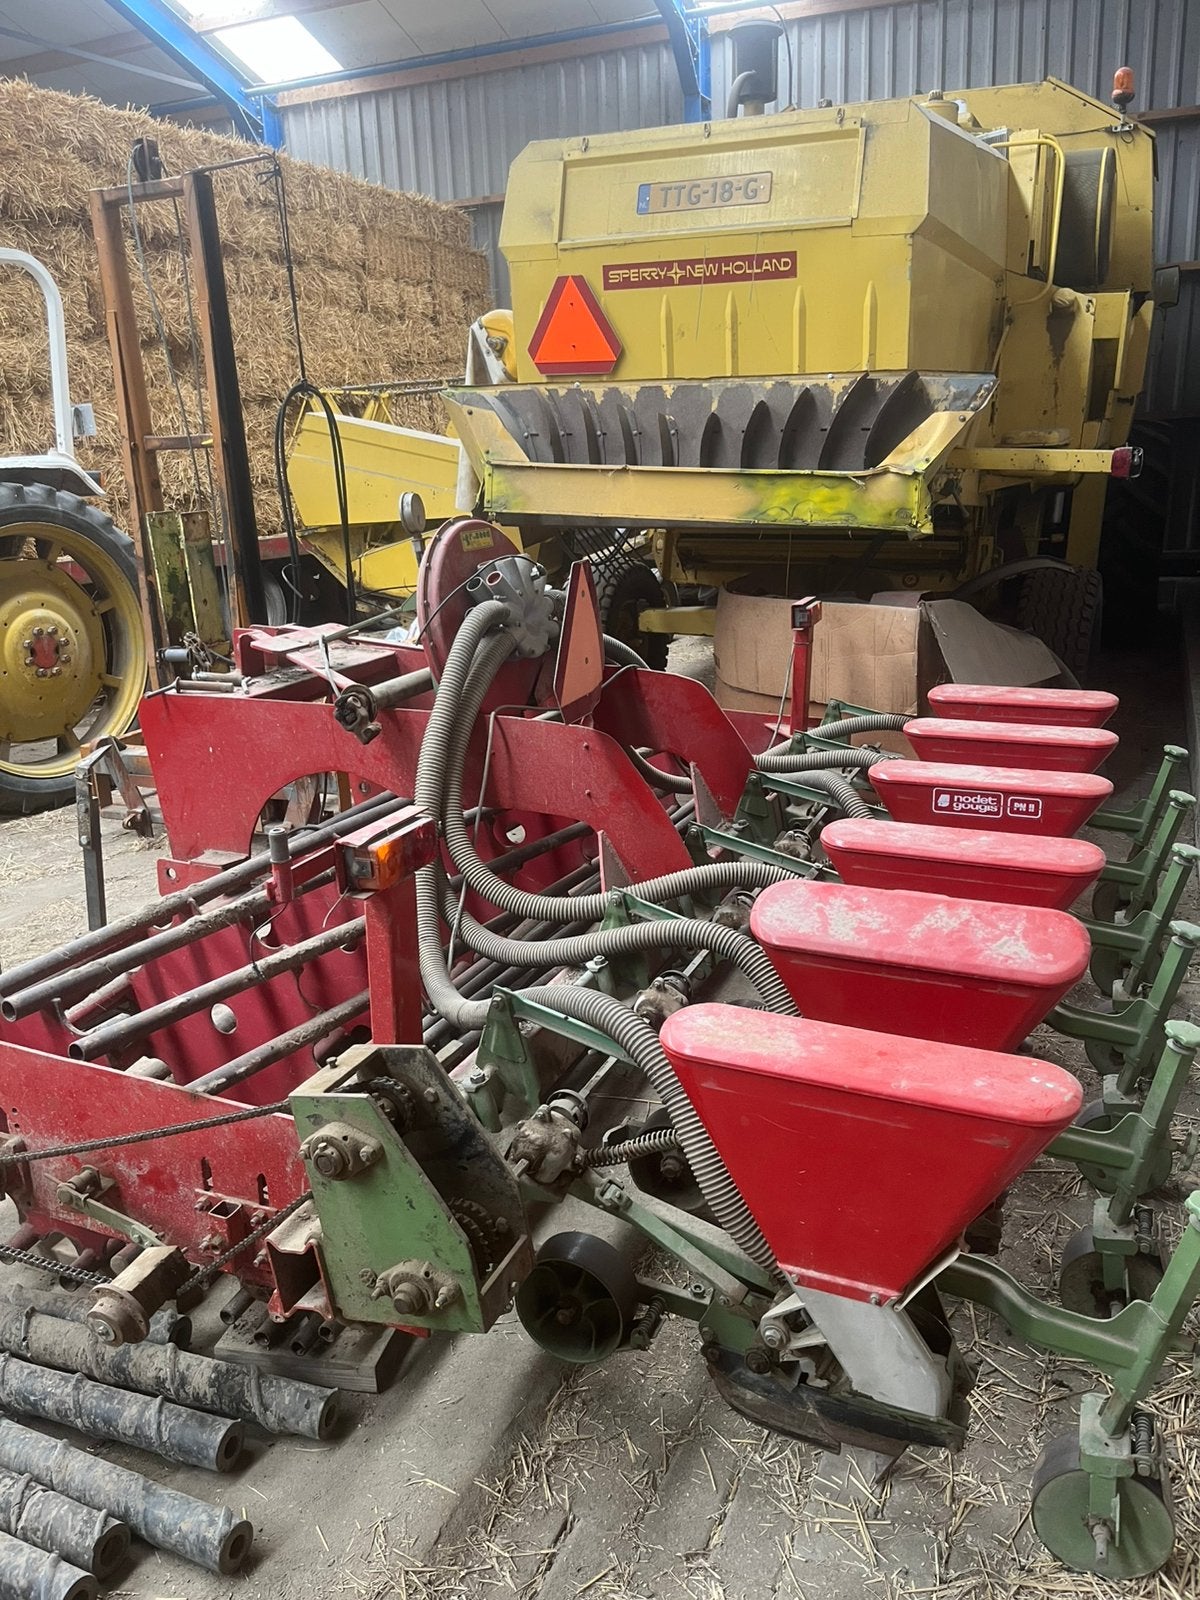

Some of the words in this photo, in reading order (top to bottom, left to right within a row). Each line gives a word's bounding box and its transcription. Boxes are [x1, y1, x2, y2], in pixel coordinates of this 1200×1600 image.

[660, 177, 759, 208] TTG-18-G
[608, 267, 667, 283] SPERRY
[686, 262, 719, 277] NEW
[721, 257, 792, 275] HOLLAND
[952, 801, 998, 813] gougis
[953, 794, 998, 805] nodet
